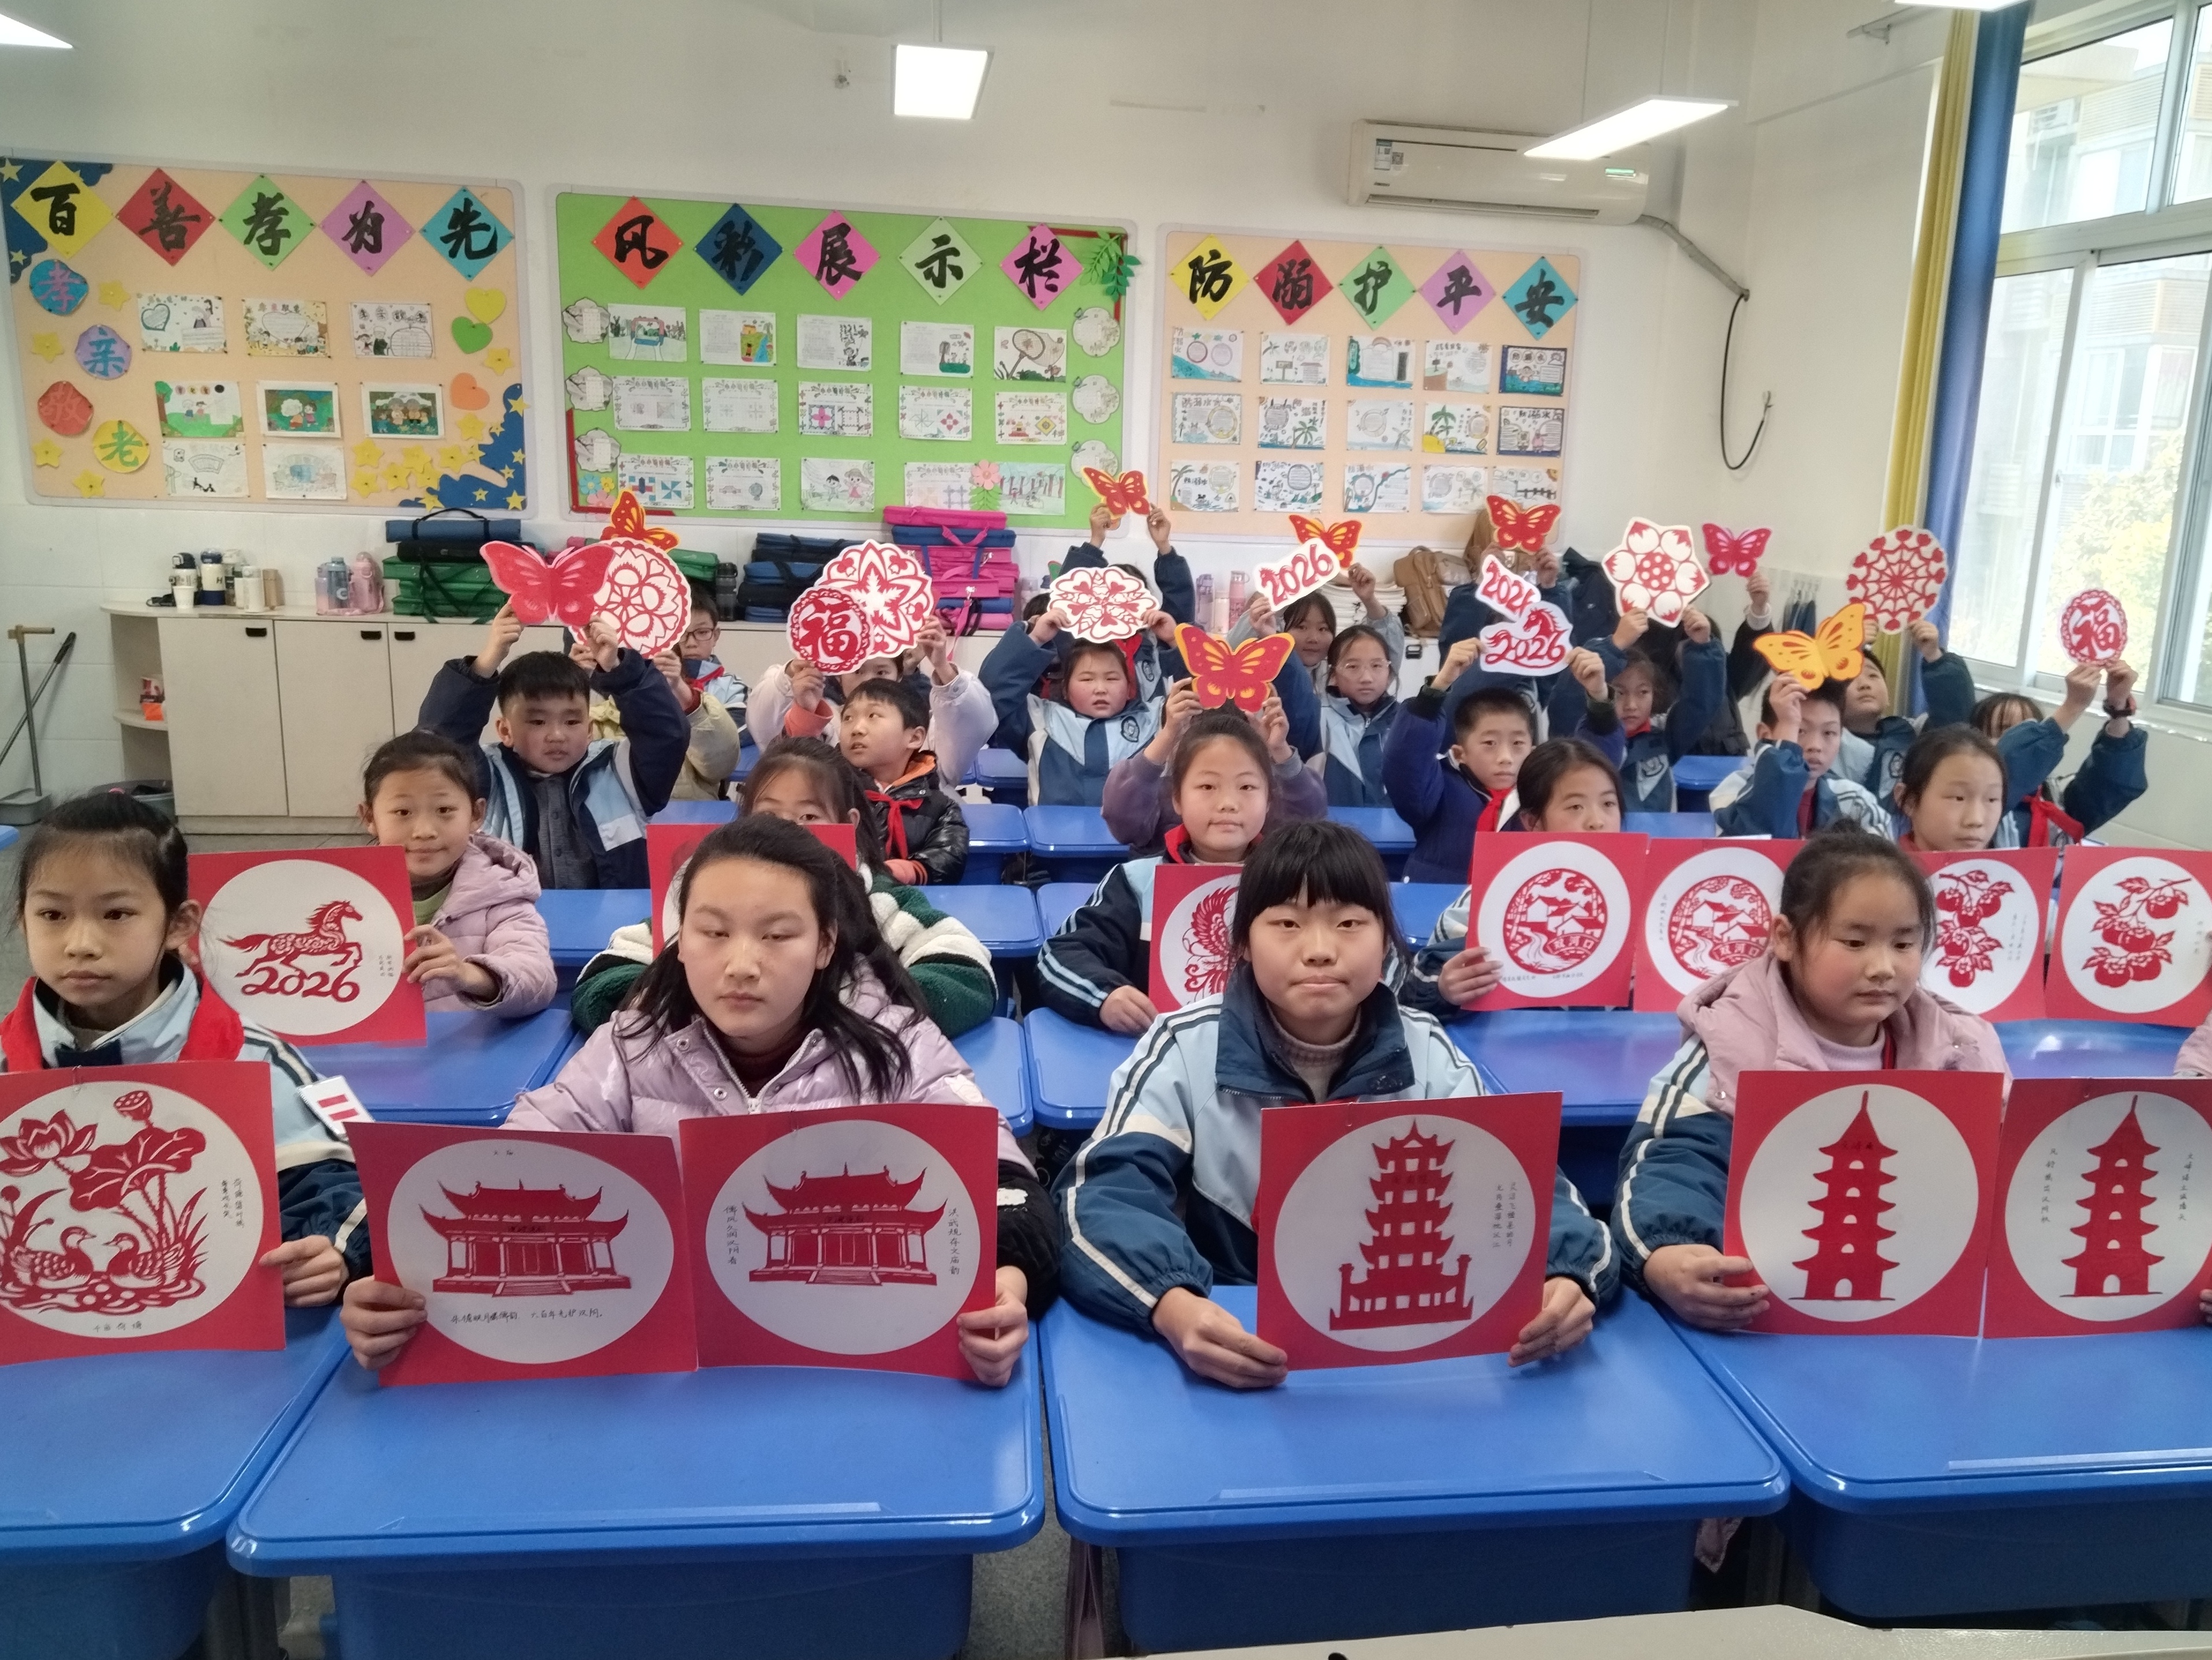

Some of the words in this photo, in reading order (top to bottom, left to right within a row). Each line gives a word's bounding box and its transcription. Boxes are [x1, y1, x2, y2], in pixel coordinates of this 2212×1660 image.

[31, 182, 497, 260] 百善孝为先
[38, 264, 81, 315] 孝
[1188, 249, 1565, 327] 防溺护平安
[83, 328, 125, 377] 亲
[43, 386, 91, 424] 敬
[101, 422, 143, 469] 老
[1259, 544, 1335, 606] 2026
[799, 599, 859, 660] 福
[1484, 628, 1569, 668] 2026
[2072, 598, 2122, 660] 福
[1554, 936, 1595, 950] 双河口
[1720, 943, 1760, 957] 双河口
[241, 966, 361, 1003] 2026
